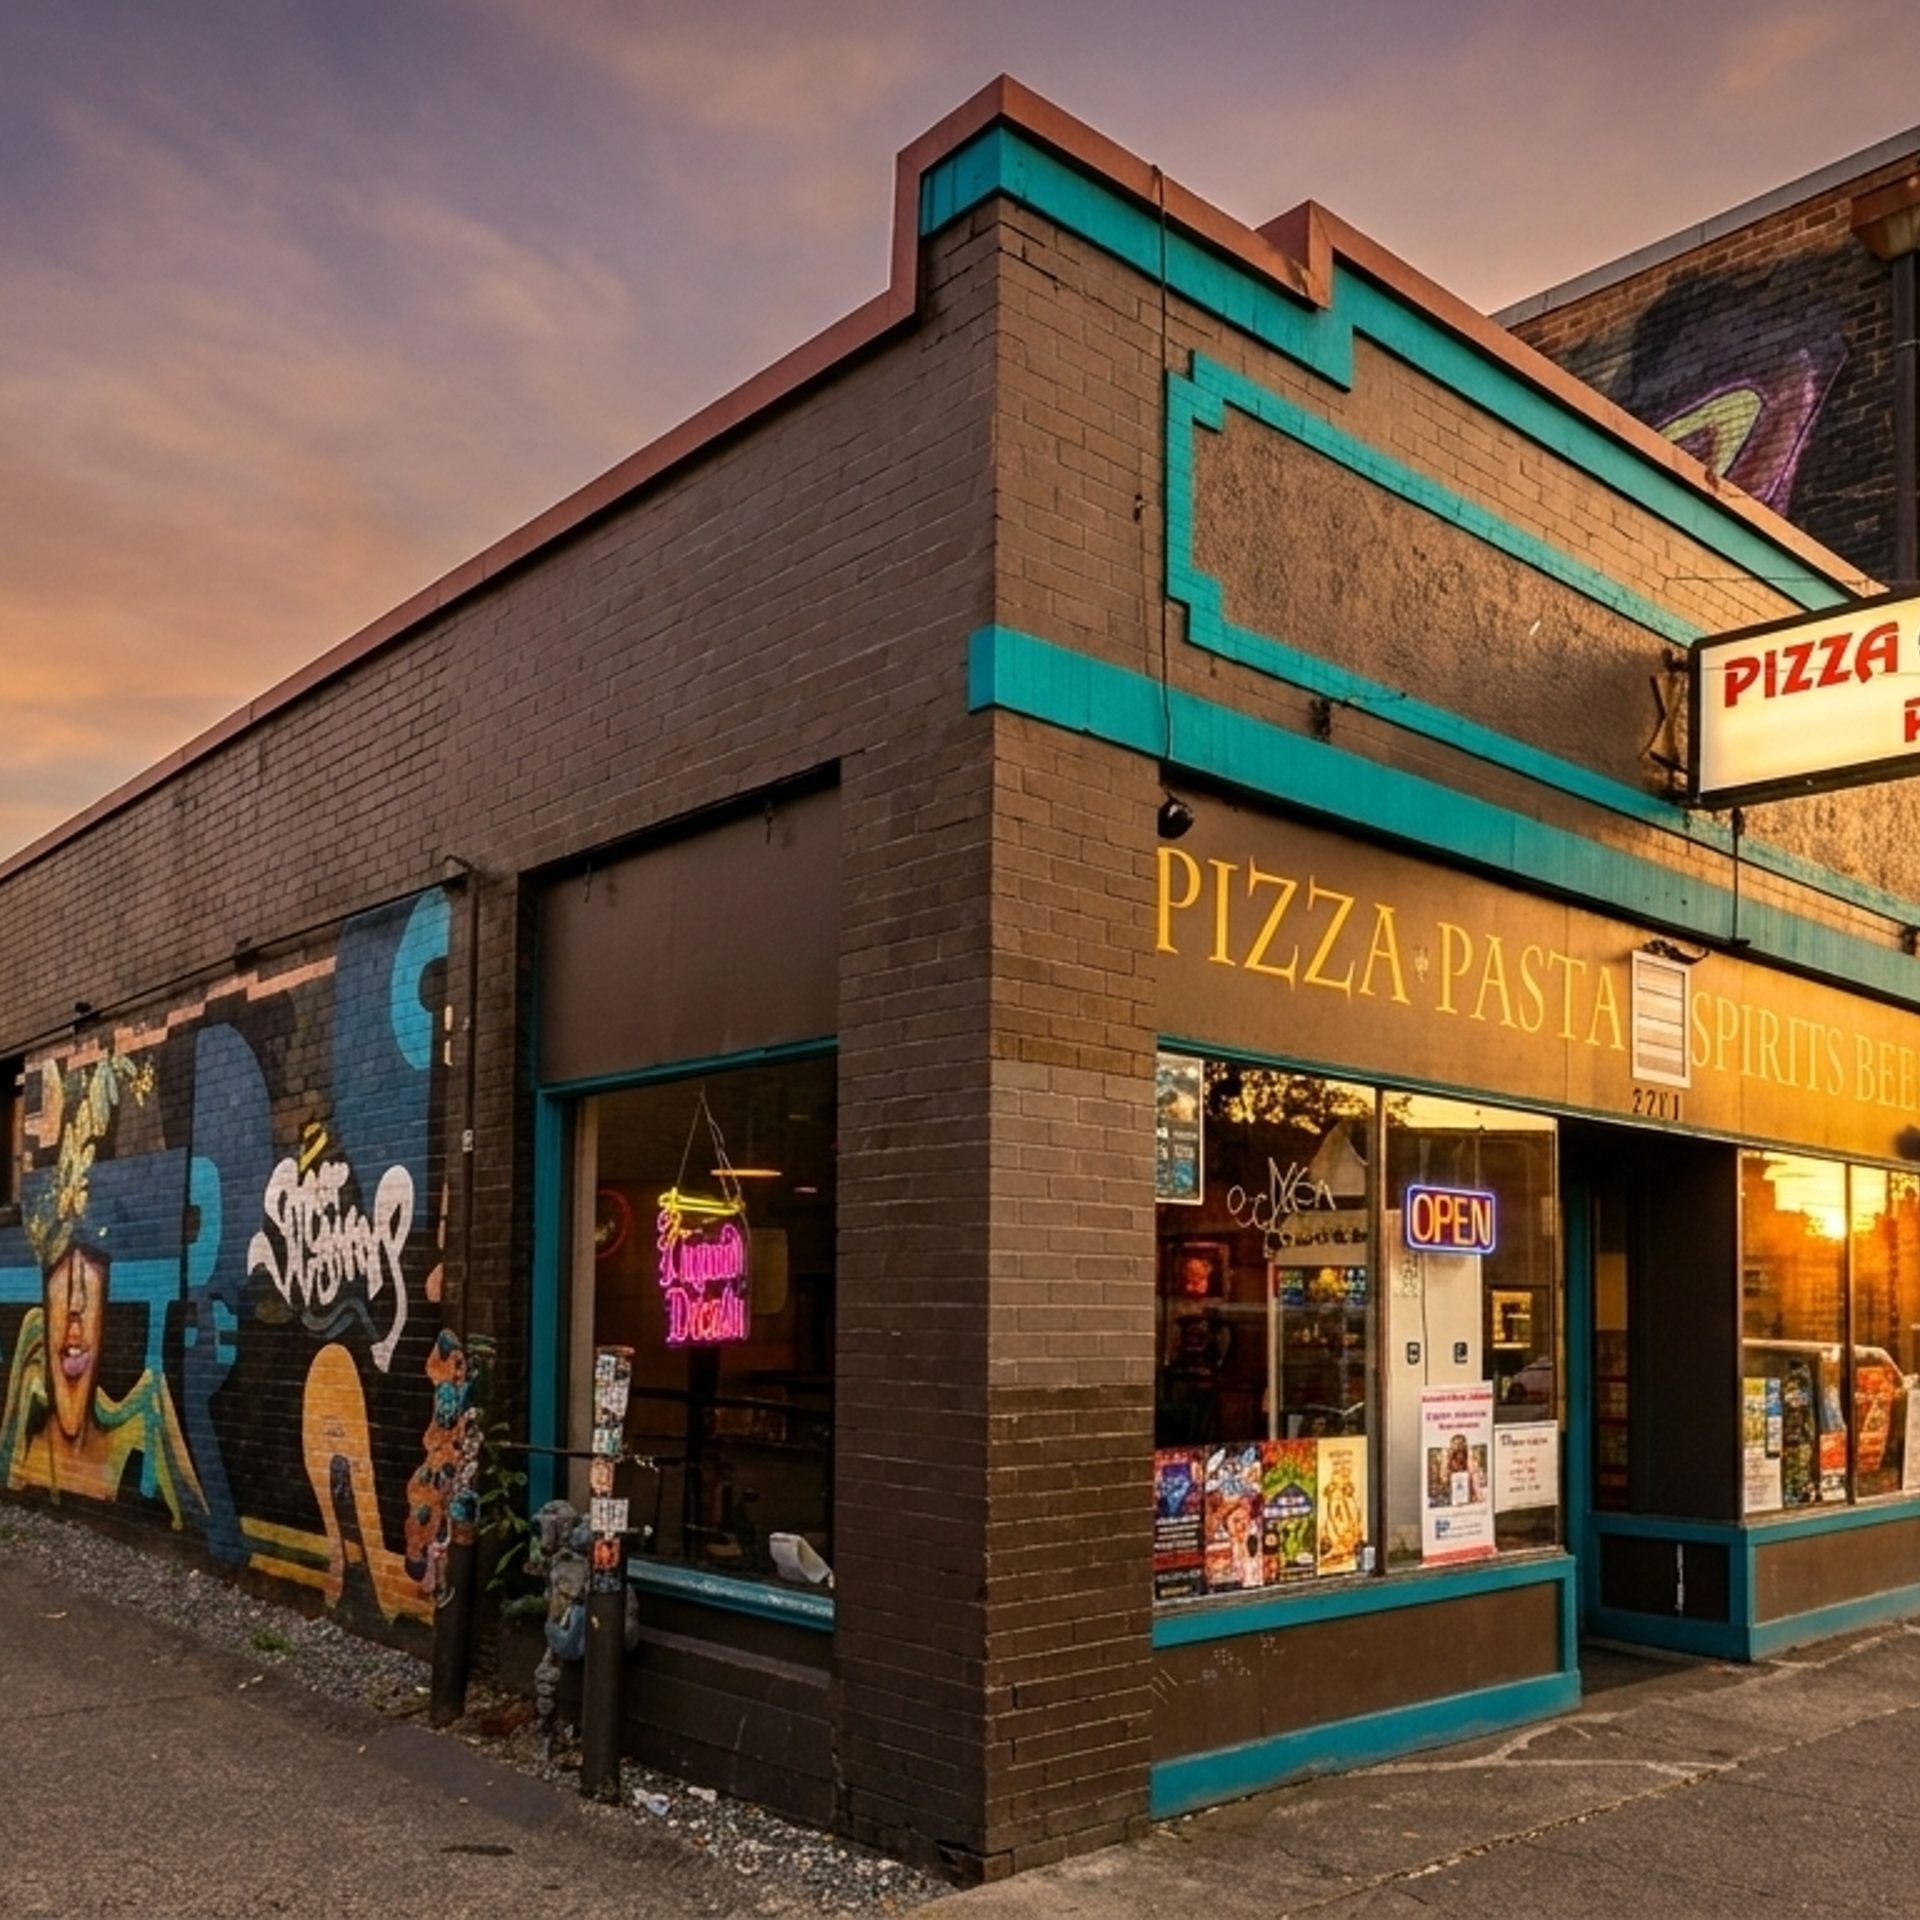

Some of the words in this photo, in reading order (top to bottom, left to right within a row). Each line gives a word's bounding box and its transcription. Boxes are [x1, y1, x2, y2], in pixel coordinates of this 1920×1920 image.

[1724, 621, 1899, 708] PIZZA
[1156, 847, 1411, 1006] PIZZA
[1435, 921, 1626, 1051] PASTA
[1691, 991, 1845, 1097] SPIRITS
[1854, 1033, 1920, 1112] BEE
[1412, 1193, 1491, 1246] OPEN
